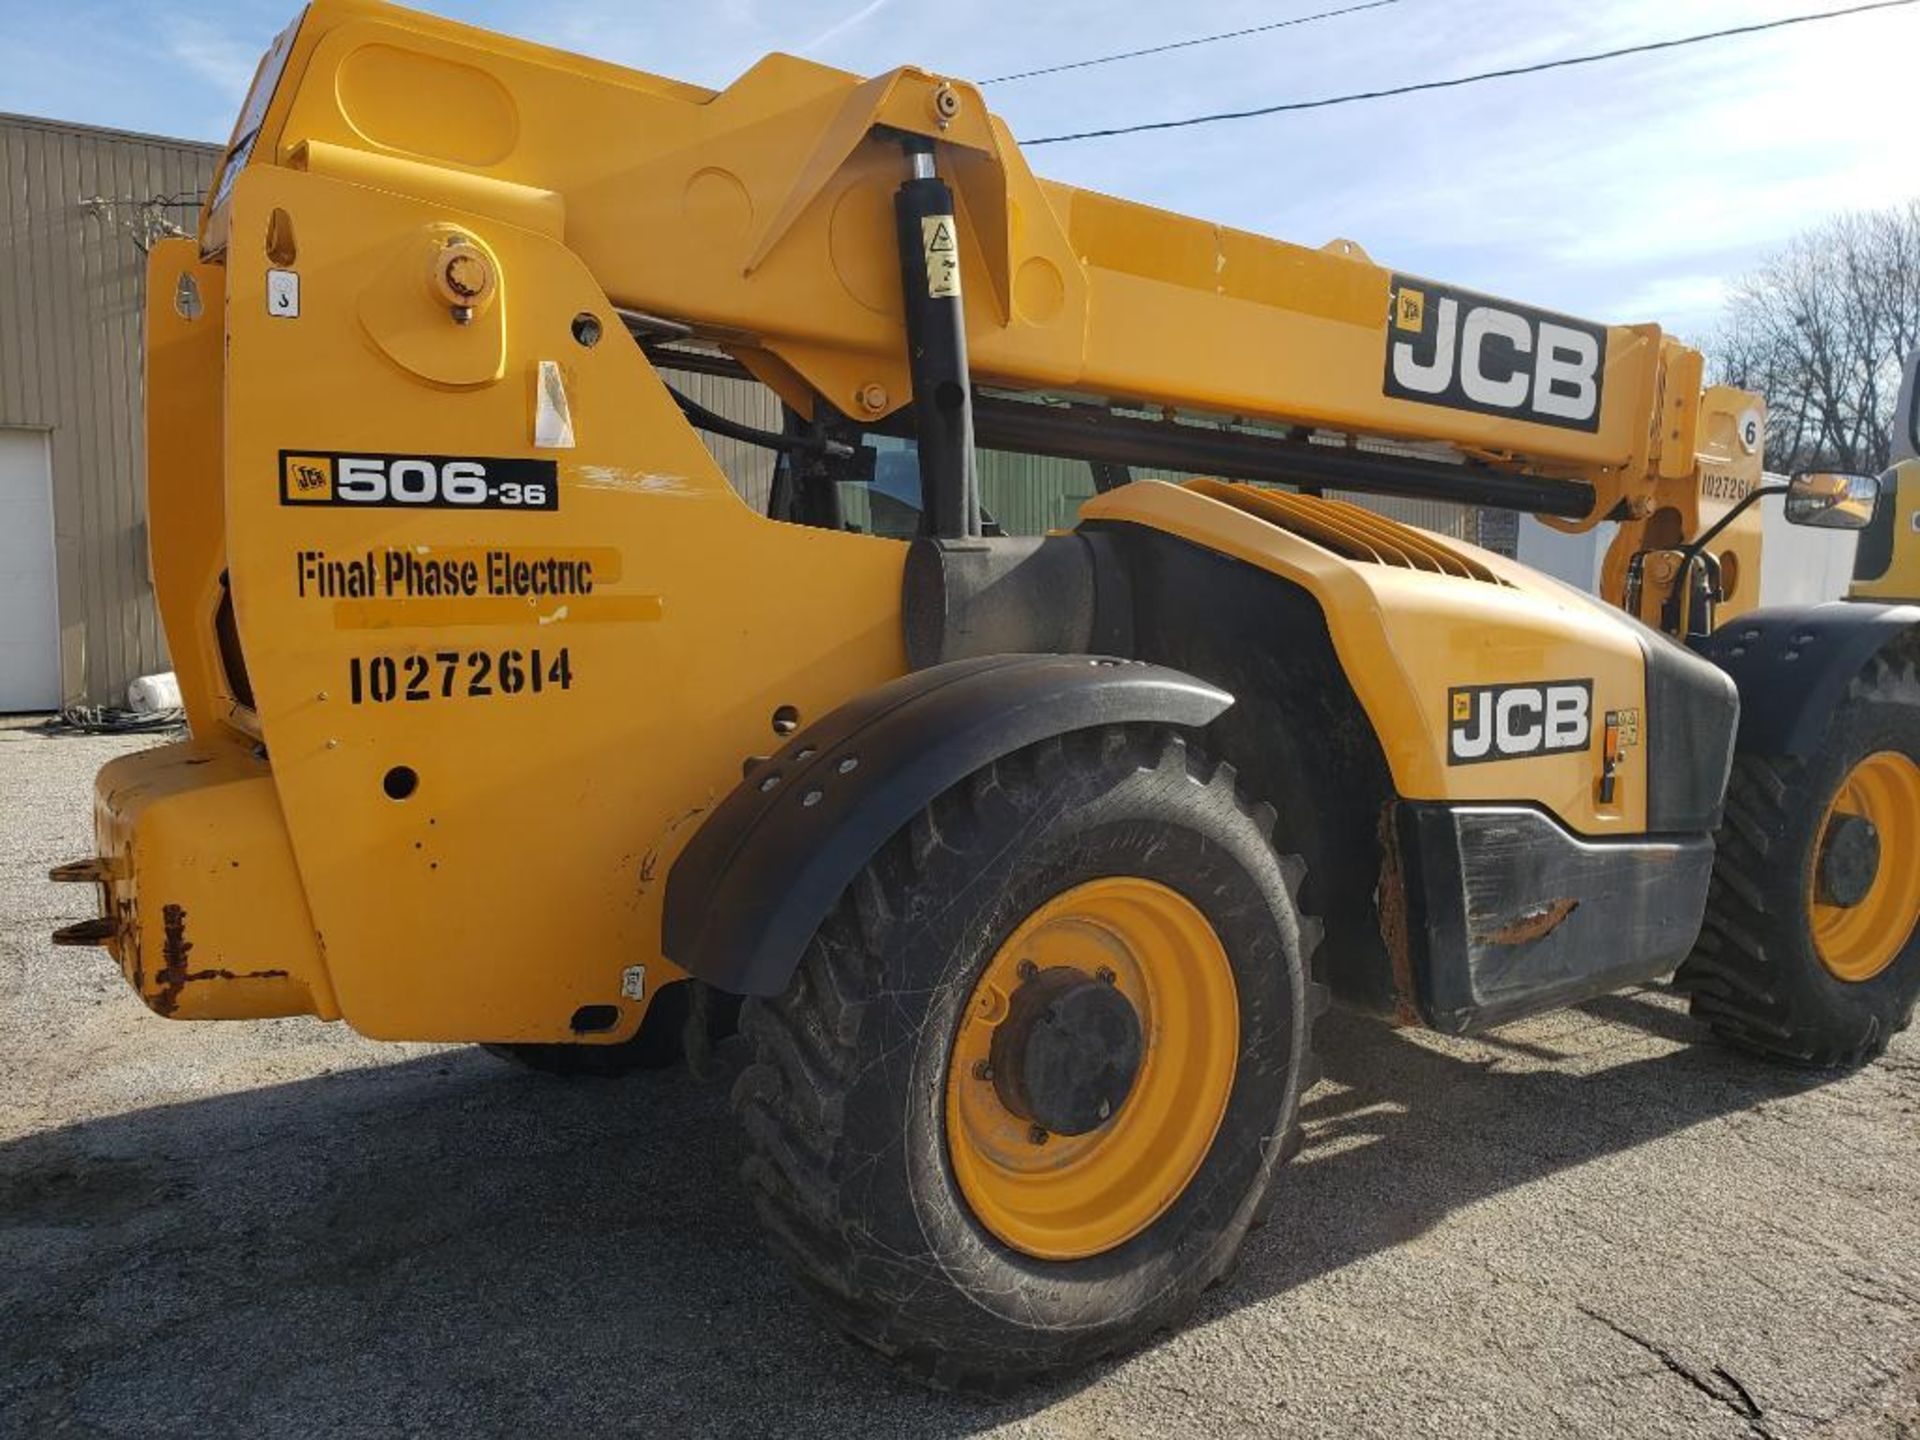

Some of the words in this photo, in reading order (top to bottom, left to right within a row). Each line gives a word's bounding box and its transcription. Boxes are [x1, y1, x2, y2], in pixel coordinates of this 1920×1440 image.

[1392, 297, 1600, 421] JCB
[1745, 421, 1757, 445] 6
[337, 458, 546, 505] 506-36
[297, 551, 375, 598] Final
[385, 551, 478, 597] Phase
[486, 552, 593, 596] Electric
[350, 648, 573, 705] 10272614
[1452, 685, 1589, 758] JCB
